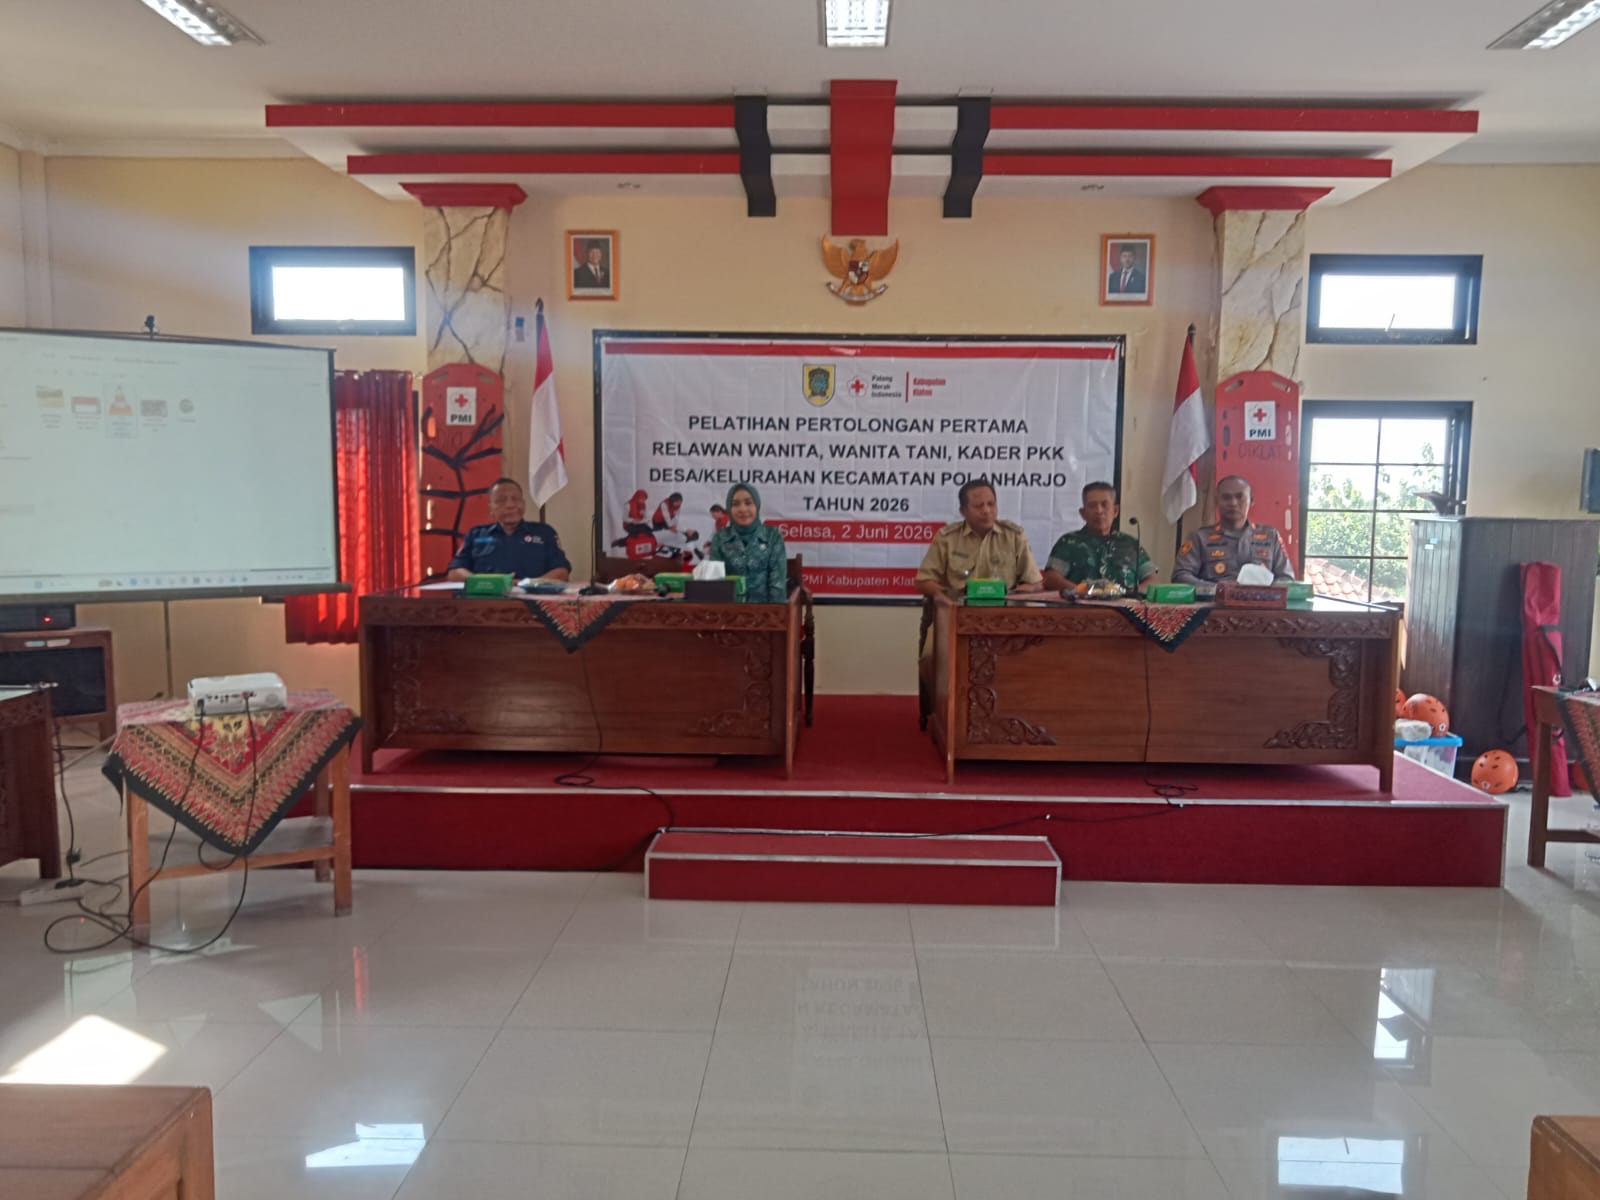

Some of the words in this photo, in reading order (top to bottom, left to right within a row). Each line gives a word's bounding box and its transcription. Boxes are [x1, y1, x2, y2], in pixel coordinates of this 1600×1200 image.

[451, 414, 472, 424] PMI
[688, 416, 790, 431] PELATIHAN
[796, 417, 934, 433] PERTOLONGAN
[940, 419, 1028, 434] PERTAMA
[1249, 429, 1271, 438] PMI
[652, 441, 743, 457] RELAWAN
[748, 443, 824, 460] WANITA,
[829, 445, 900, 459] WANITA
[905, 446, 952, 461] TANI,
[958, 446, 1021, 460] KADER
[1027, 447, 1064, 460] PKK
[649, 468, 815, 485] DESA/KELURAHAN
[821, 471, 935, 486] KECAMATAN
[803, 496, 864, 511] TAHUN
[870, 498, 909, 512] 2026
[779, 523, 836, 539] Selasa,
[841, 525, 851, 538] 2
[856, 525, 889, 540] Juni
[894, 526, 933, 540] 2026
[826, 575, 889, 587] Kabupaten
[892, 576, 916, 586] Klat
